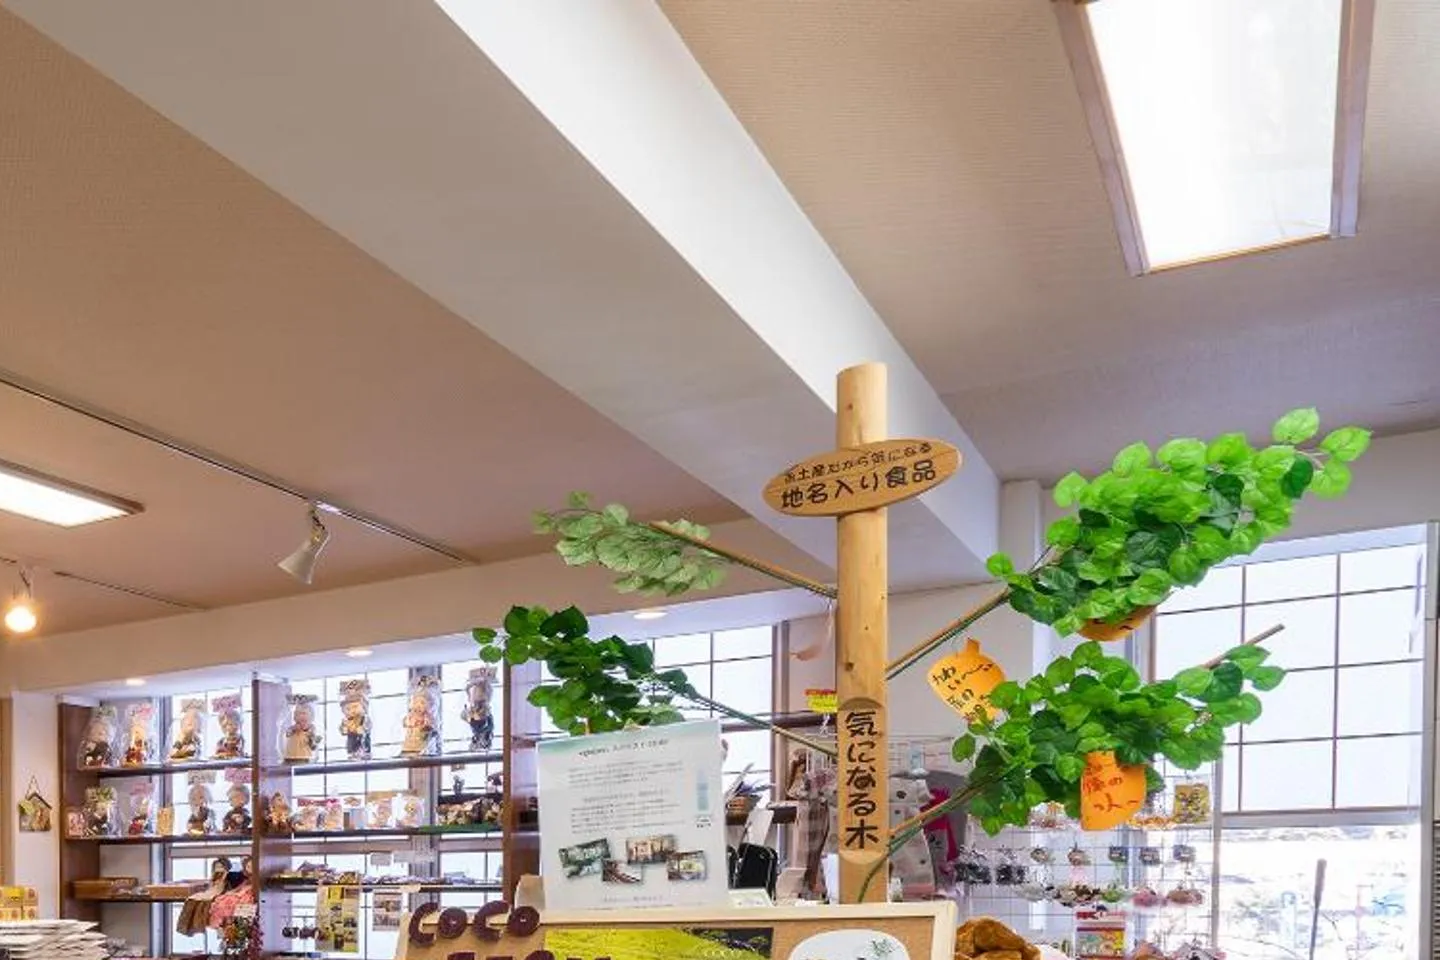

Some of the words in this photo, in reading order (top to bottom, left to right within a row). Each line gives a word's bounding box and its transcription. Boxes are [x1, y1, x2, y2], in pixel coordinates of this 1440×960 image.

[781, 459, 936, 508] 地名入り食品
[844, 711, 880, 850] 気になる木
[409, 900, 540, 945] COCO
